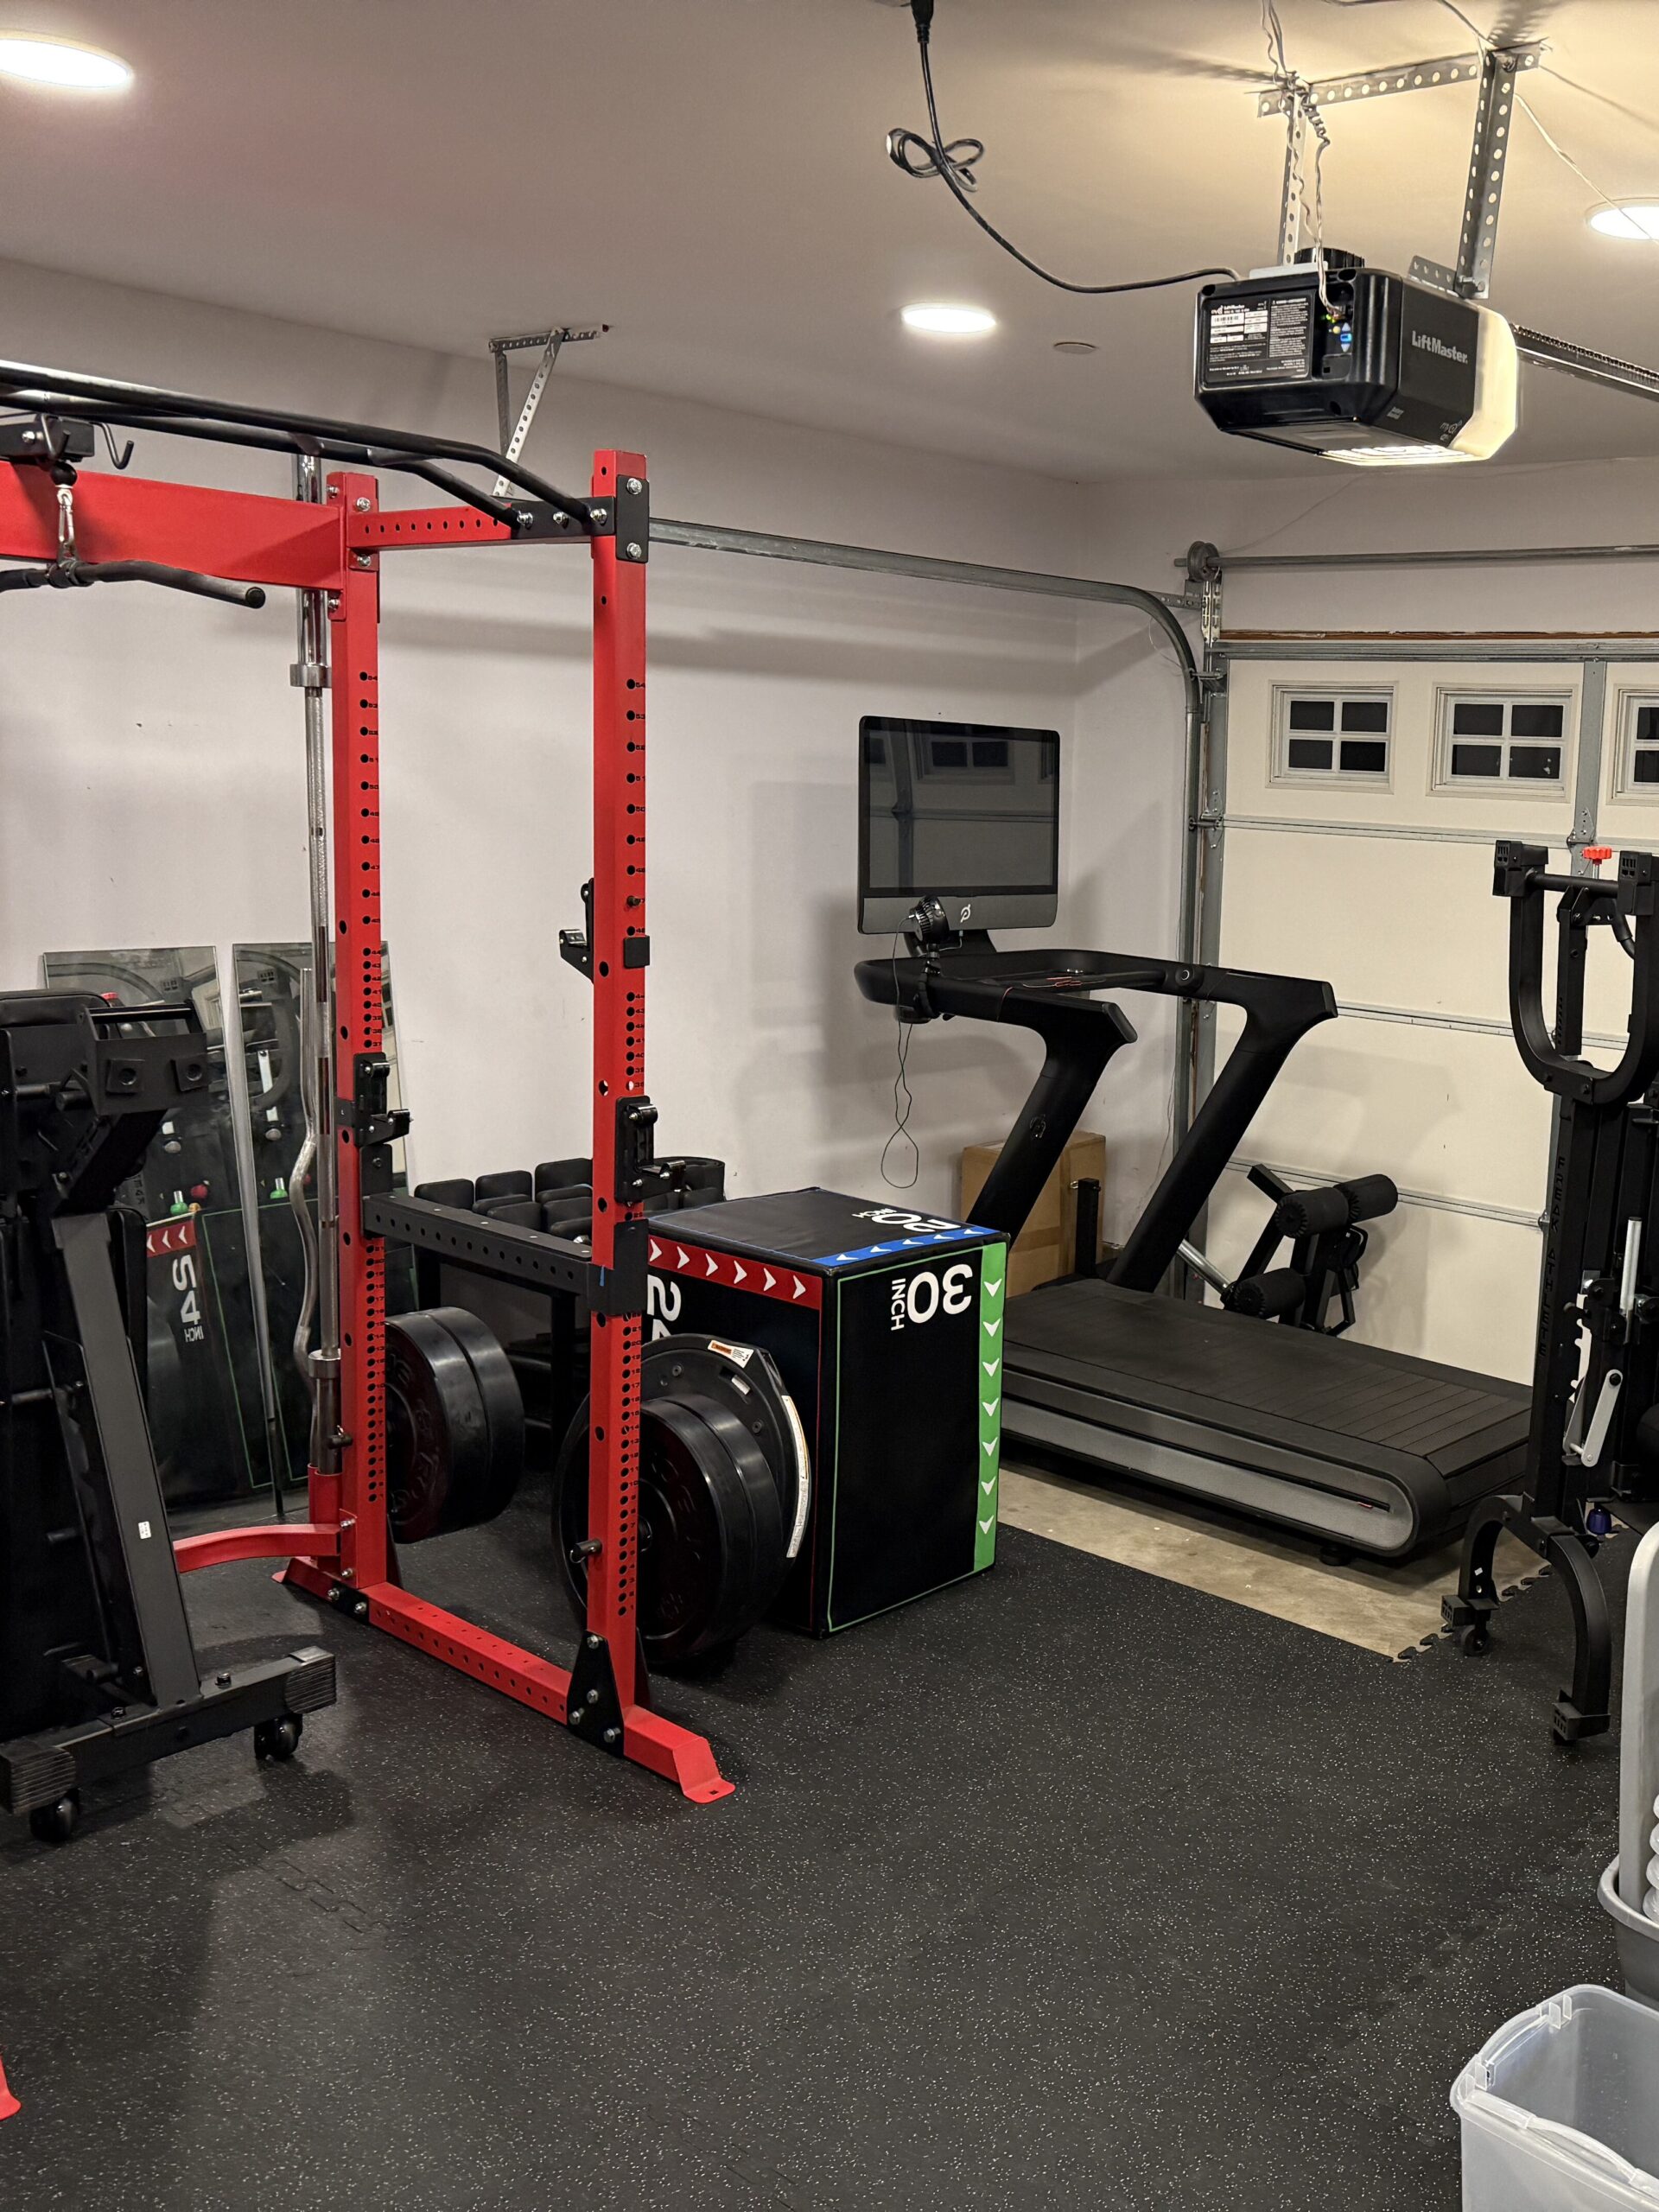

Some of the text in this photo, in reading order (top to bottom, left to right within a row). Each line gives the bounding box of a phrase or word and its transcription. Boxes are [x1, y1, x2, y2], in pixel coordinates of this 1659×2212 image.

[1411, 330, 1467, 364] LiftMaster
[871, 1213, 961, 1233] 20
[1551, 1157, 1566, 1233] FREAK
[890, 1278, 906, 1331] INCH
[907, 1264, 973, 1324] 30
[1539, 1248, 1556, 1357] ATHLETE
